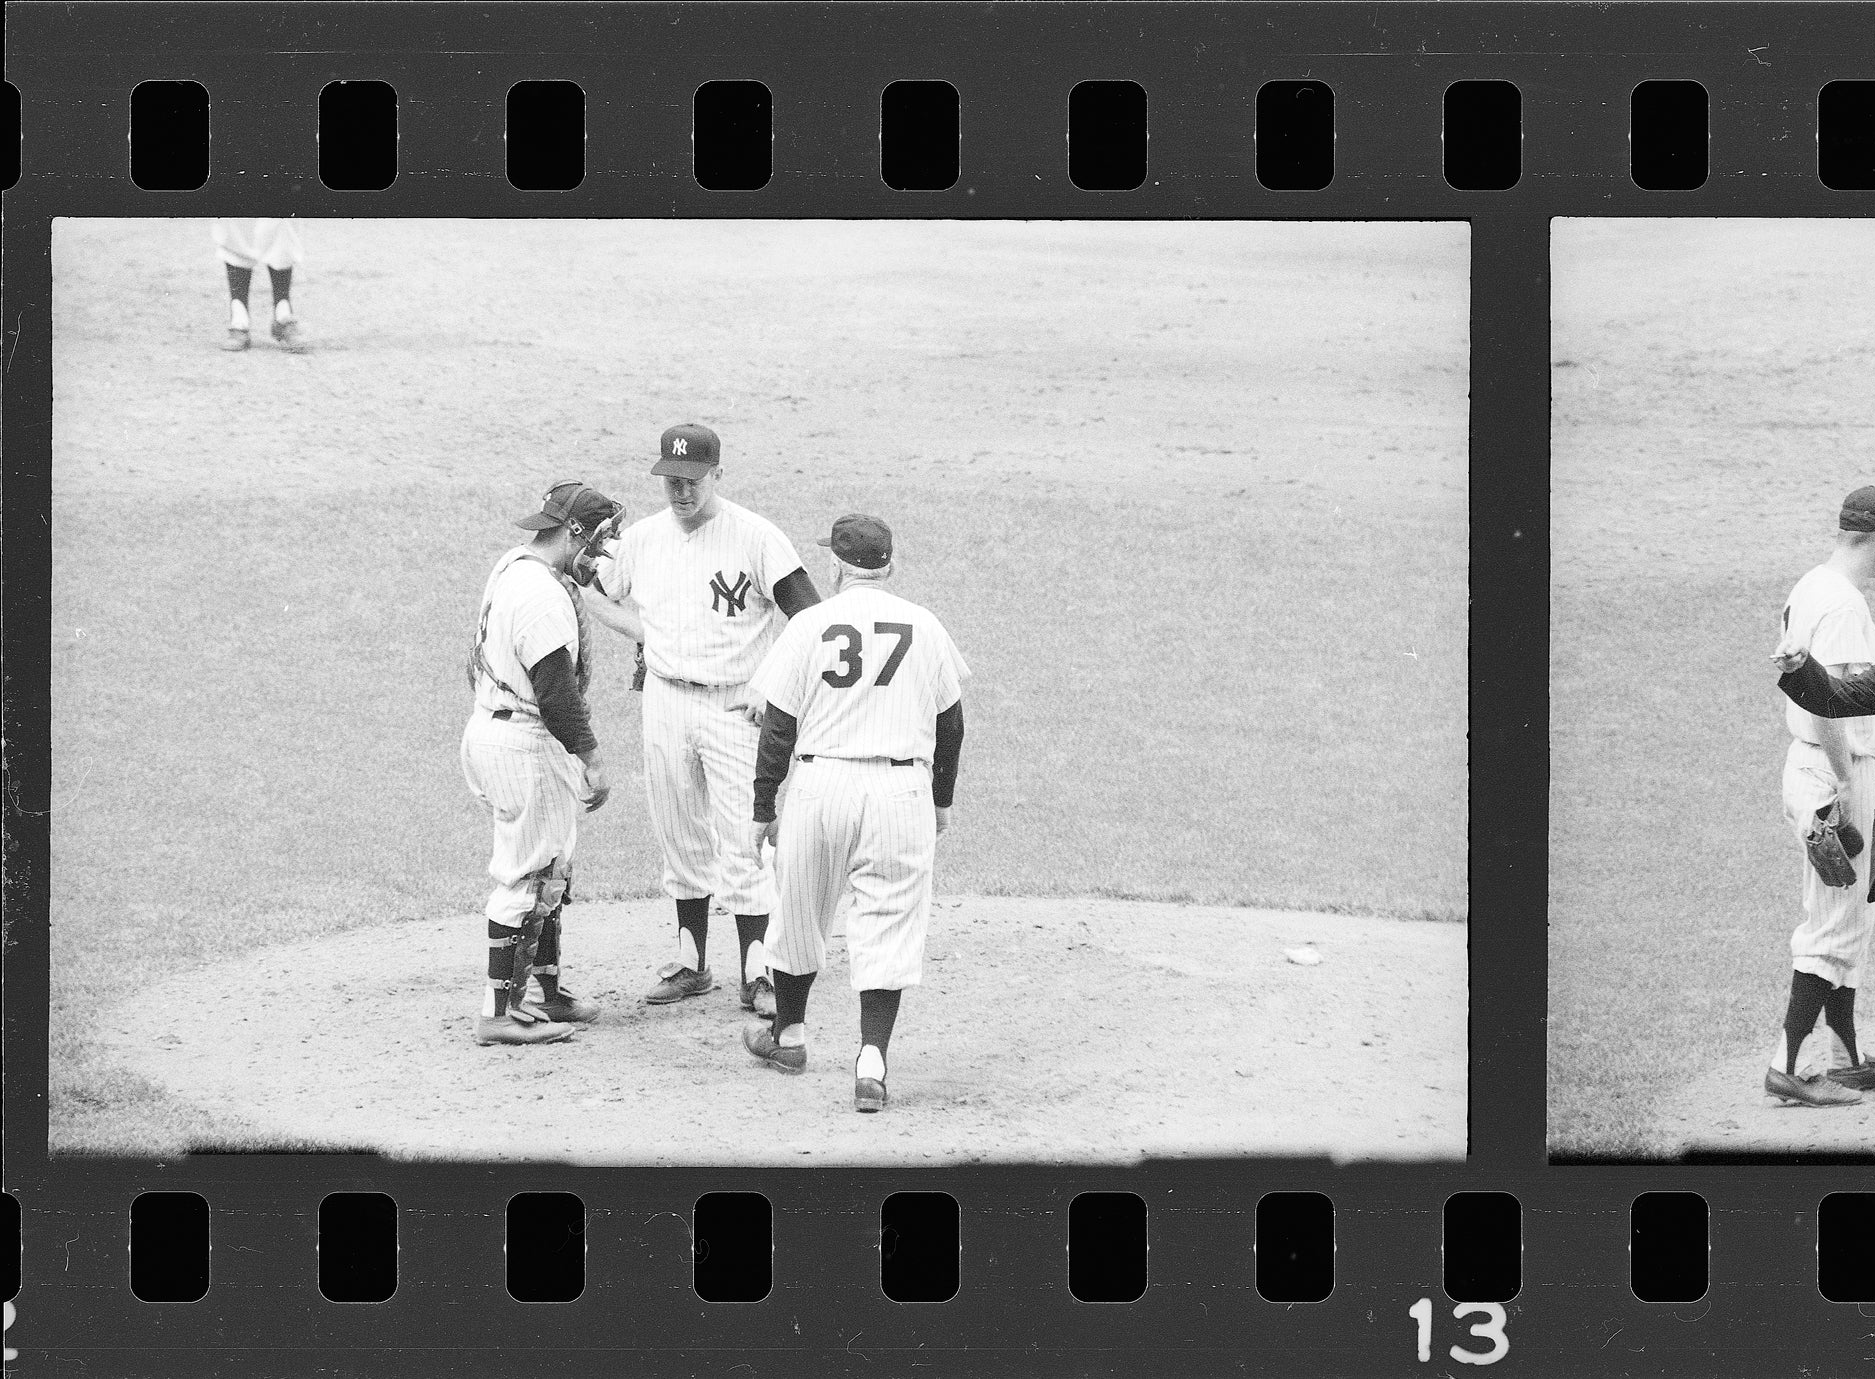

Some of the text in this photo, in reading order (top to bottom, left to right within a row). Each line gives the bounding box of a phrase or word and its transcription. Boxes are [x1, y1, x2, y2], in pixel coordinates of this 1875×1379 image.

[709, 570, 752, 617] NY
[821, 621, 913, 689] 37
[1409, 1299, 1509, 1366] 13
